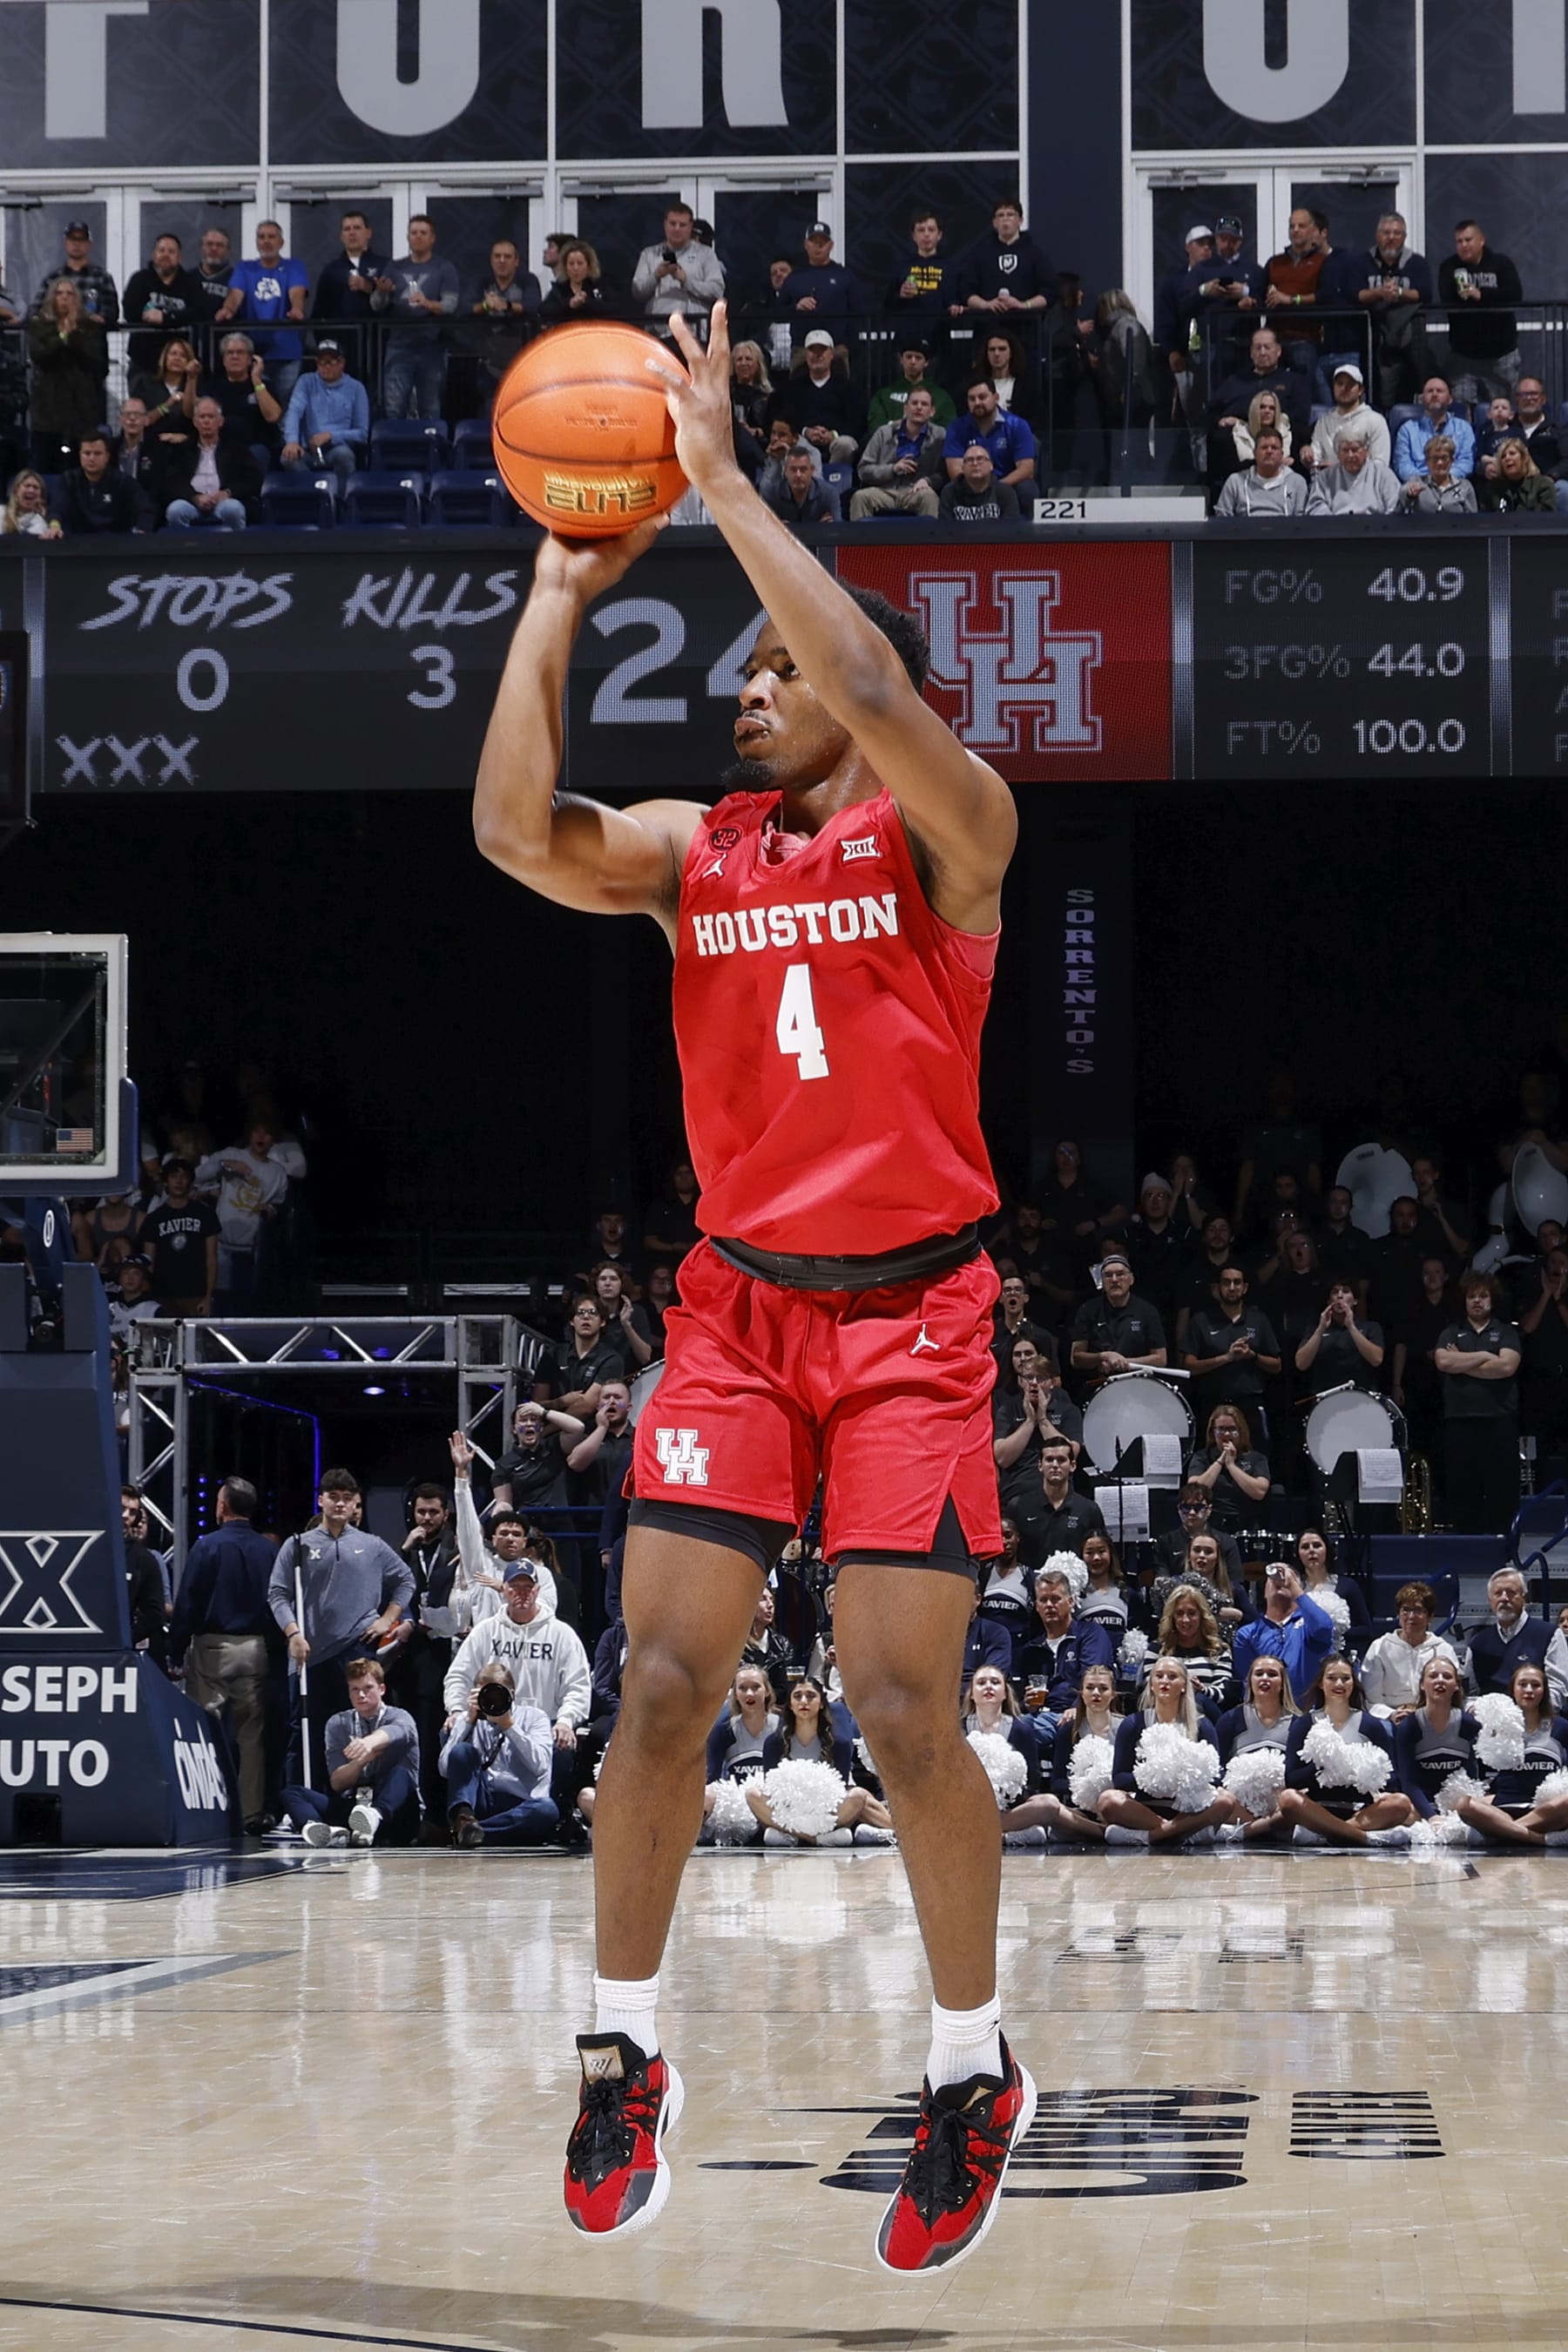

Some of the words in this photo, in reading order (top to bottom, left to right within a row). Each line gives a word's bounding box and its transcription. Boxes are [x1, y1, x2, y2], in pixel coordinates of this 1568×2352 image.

[1040, 501, 1087, 519] 221
[78, 569, 295, 632] STOPS
[341, 566, 519, 632] KILLS
[1224, 569, 1323, 604] FG%
[1368, 567, 1464, 602] 40.9
[177, 646, 230, 712] 0
[407, 645, 457, 708] 3
[1224, 645, 1351, 679] 3FG%
[1368, 643, 1465, 678] 44.0
[55, 734, 200, 787] XXX
[1227, 720, 1321, 755] FT%
[1352, 718, 1466, 754] 100.0
[693, 893, 899, 956] HOUSTON
[1063, 889, 1098, 1074] SORRENTO'S
[775, 963, 830, 1081] 4
[159, 1217, 202, 1237] XAVIER
[655, 1428, 710, 1486] UH
[981, 1599, 1020, 1611] XAVIER
[1, 1665, 139, 1713] SEPH
[0, 1739, 110, 1788] UTO
[733, 1765, 764, 1774] XAVIE
[1287, 2091, 1447, 2160] CENTER
